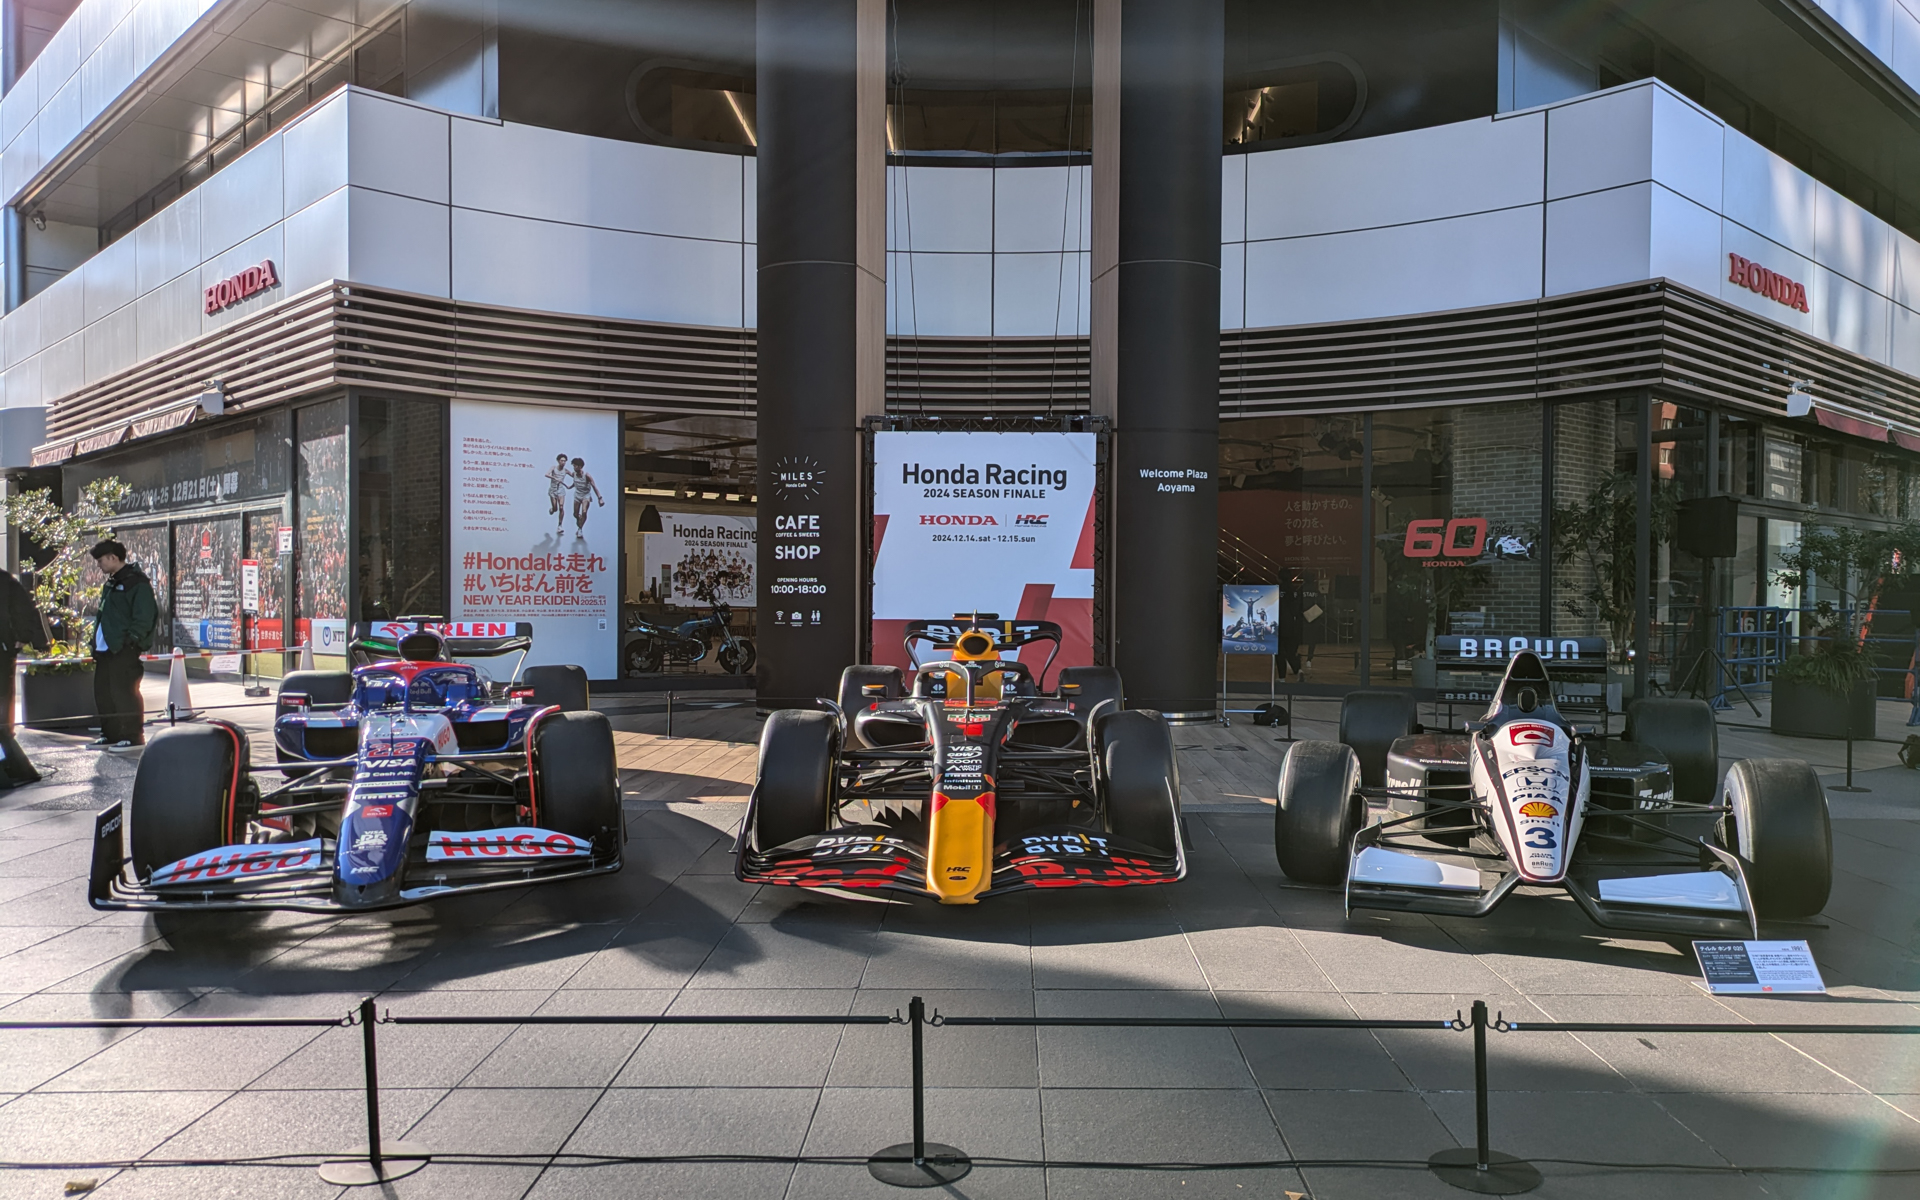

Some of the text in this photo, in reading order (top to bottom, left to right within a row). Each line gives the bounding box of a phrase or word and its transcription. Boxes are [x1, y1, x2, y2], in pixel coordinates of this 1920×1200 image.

[203, 258, 278, 314] HONDA
[1728, 252, 1810, 314] HONDA
[780, 472, 813, 481] MILES
[902, 463, 1067, 491] Honda Racing
[1139, 468, 1208, 479] Welcome Plaza
[923, 488, 1046, 499] 2024 SEASON FINALE
[1157, 482, 1196, 494] Aoyama
[1284, 499, 1353, 512] 人を動かすもの。
[775, 515, 820, 530] CAFE
[919, 515, 999, 526] HONDA
[1015, 514, 1049, 525] HRC
[1284, 517, 1324, 529] その力を、
[673, 524, 757, 543] Honda Racing
[1490, 525, 1514, 535] 1964
[932, 534, 991, 542] 2024.12.14.sat
[997, 535, 1036, 543] 12.15.sun
[1284, 533, 1347, 547] 夢と呼びたい。
[1403, 517, 1488, 557] 60
[700, 540, 725, 548] SEASON
[726, 541, 748, 549] FINALE
[775, 545, 821, 560] SHOP
[463, 551, 607, 572] #Hondaは走れ
[463, 573, 594, 593] #いちばん前を
[770, 584, 827, 594] 10:00-18:00
[463, 594, 580, 605] NEW YEAR EKIDEN
[425, 622, 506, 636] RLEN
[332, 630, 346, 642] NTT
[1459, 637, 1580, 660] BRAUN
[1445, 692, 1493, 700] BRAU
[368, 742, 417, 757] 22
[360, 758, 417, 768] VISA
[1502, 765, 1570, 782] EPSON
[1514, 786, 1561, 795] HONDA
[1512, 792, 1564, 805] PIAA
[1520, 819, 1560, 828] Shell
[1524, 826, 1557, 849] 3
[440, 834, 577, 856] HUGO
[168, 850, 312, 882] HUGO
